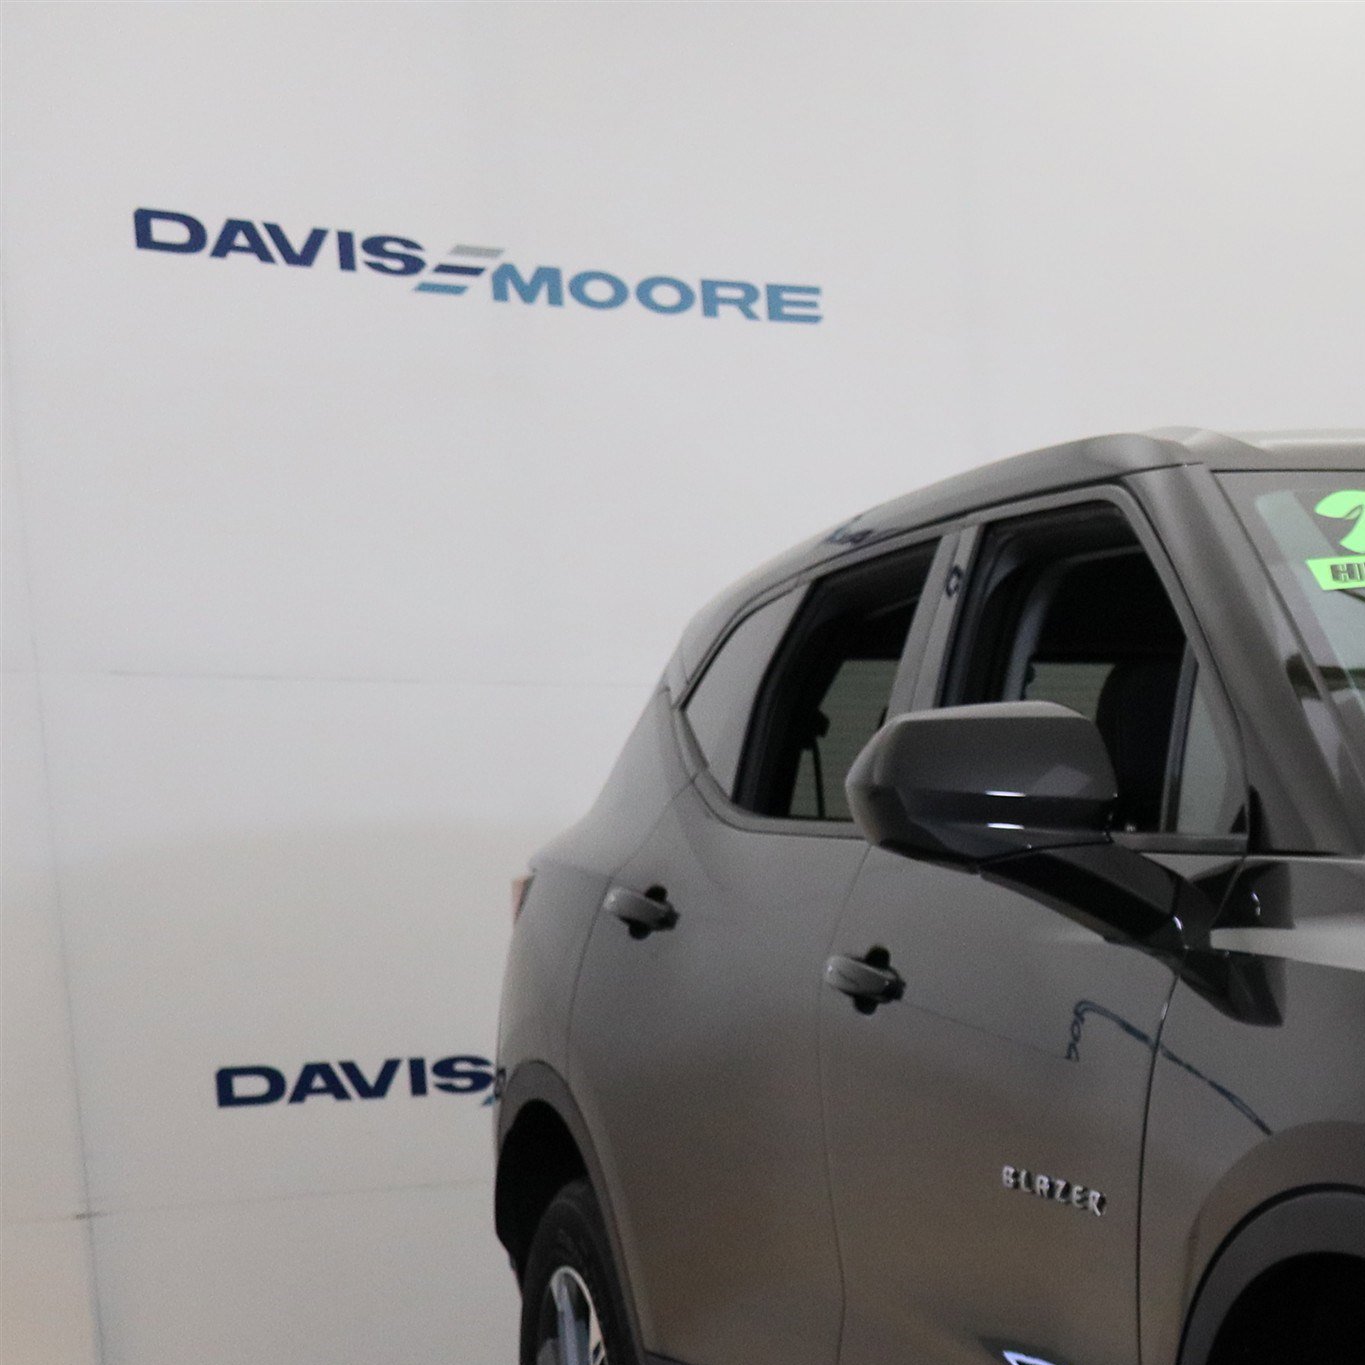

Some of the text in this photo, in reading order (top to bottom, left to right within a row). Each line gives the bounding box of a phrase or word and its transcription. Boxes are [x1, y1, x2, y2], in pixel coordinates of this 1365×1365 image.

[133, 207, 824, 325] DAVIS MOORE
[215, 1055, 494, 1109] DAVIS
[1002, 1165, 1104, 1217] BLAZER
